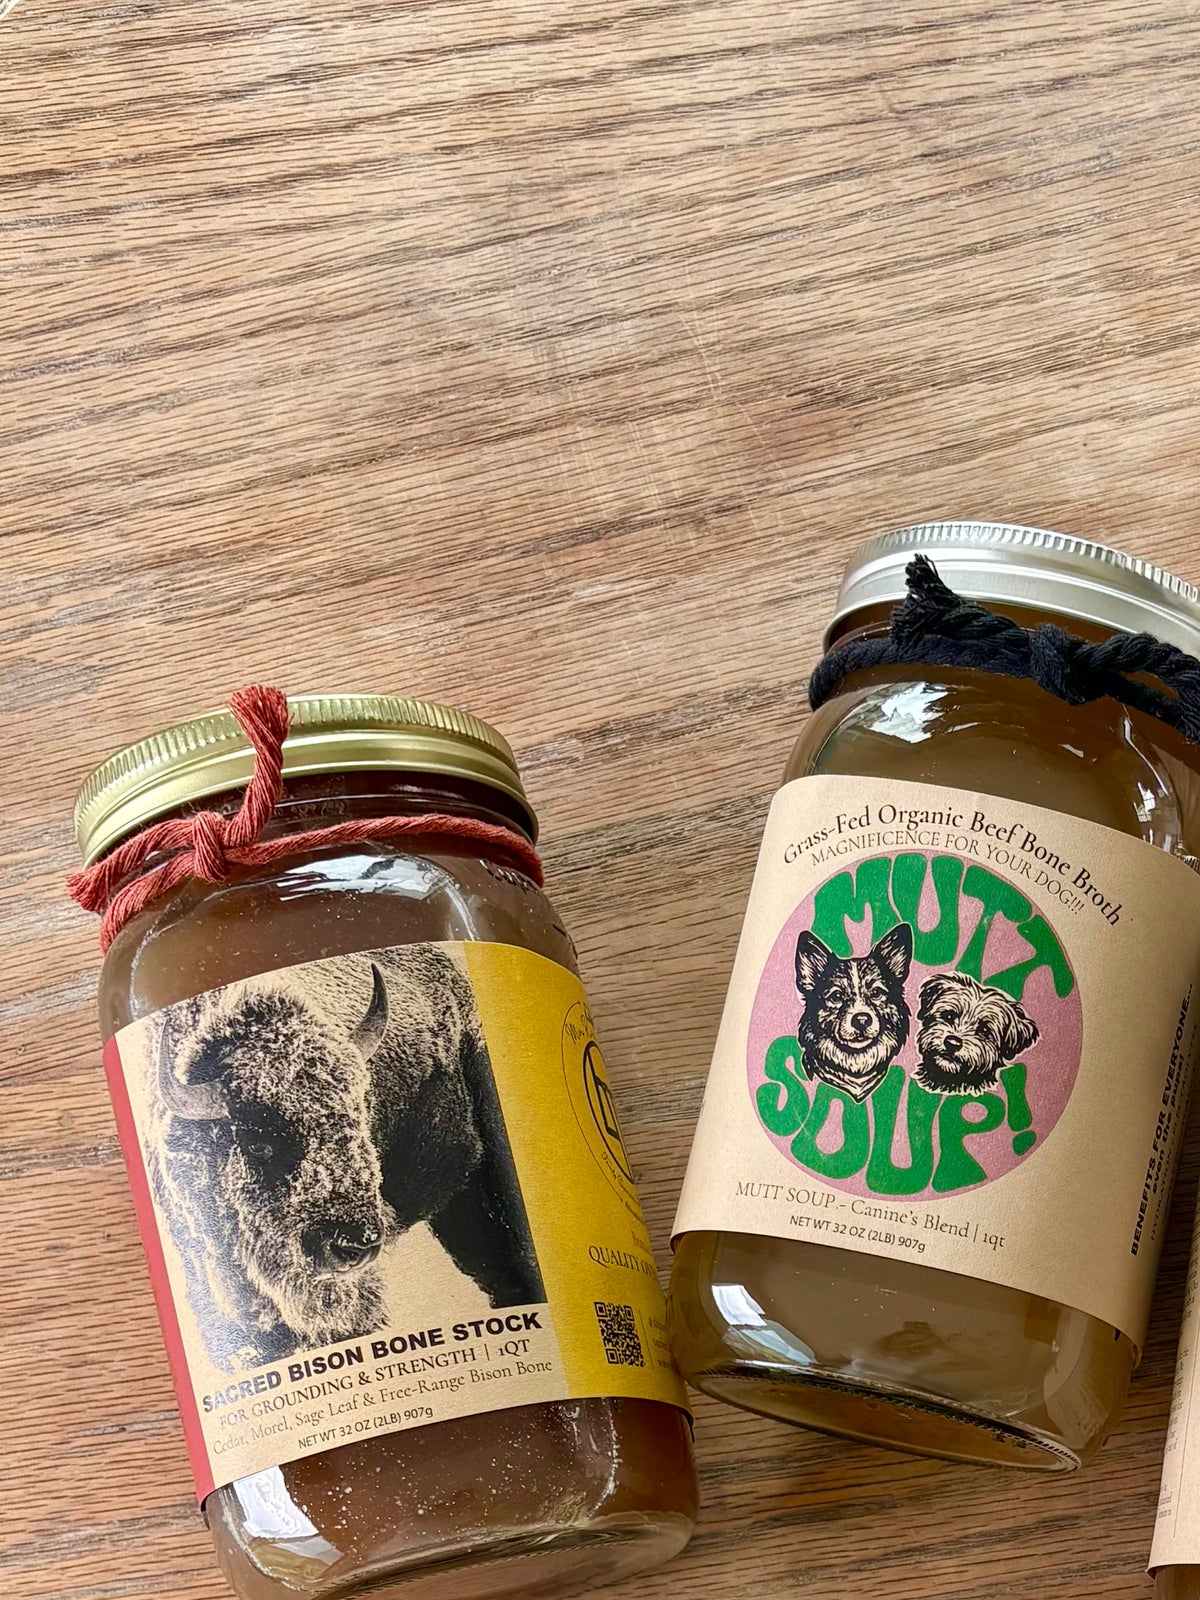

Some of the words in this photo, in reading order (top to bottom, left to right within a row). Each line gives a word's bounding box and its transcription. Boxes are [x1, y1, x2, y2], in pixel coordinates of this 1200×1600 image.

[783, 805, 870, 865] Grass-Fed
[879, 804, 963, 830] Organic
[970, 811, 1022, 843] Beef
[1020, 831, 1071, 876] Bone
[1072, 868, 1124, 927] Broth
[811, 831, 940, 866] MAGNIFICENCE
[945, 833, 980, 855] FOR
[985, 845, 1034, 880] YOUR
[1035, 867, 1086, 916] DOG!!!
[811, 853, 1075, 1003] MUTT
[755, 1035, 1037, 1195] SOUP!
[736, 1181, 783, 1202] MUTT
[786, 1187, 836, 1210] SOUP
[851, 1200, 918, 1226] Canine’s
[924, 1214, 969, 1240] Blend
[983, 1232, 1005, 1249] 1qt
[1130, 1156, 1157, 1256] BENEFITS
[1152, 1111, 1167, 1154] FOR
[588, 1245, 640, 1273] QUALITY
[790, 1215, 813, 1228] NET
[814, 1220, 833, 1232] WT
[833, 1223, 848, 1235] 32
[849, 1226, 866, 1239] OZ
[867, 1229, 896, 1246] (2LB)
[898, 1236, 926, 1253] 907g
[202, 1370, 283, 1413] SACRED
[289, 1347, 362, 1383] BISON
[370, 1327, 446, 1360] BONE
[453, 1312, 543, 1341] STOCK
[213, 1434, 249, 1456] Cedar,
[251, 1417, 293, 1442] Morel,
[295, 1405, 325, 1429] Sage
[327, 1396, 360, 1418] Leaf
[363, 1393, 377, 1406] &
[380, 1374, 467, 1402] Free-Range
[470, 1364, 512, 1384] Bison
[517, 1360, 553, 1377] Bone
[219, 1406, 249, 1429] FOR
[252, 1375, 354, 1419] GROUNDING
[358, 1371, 371, 1385] &
[374, 1347, 476, 1381] STRENGTH
[498, 1339, 530, 1358] 1QT
[298, 1435, 319, 1450] NET
[318, 1430, 337, 1444] WT
[339, 1424, 353, 1438] 32
[354, 1420, 371, 1434] OZ
[373, 1412, 402, 1430] (2LB)
[403, 1407, 434, 1421] 907g
